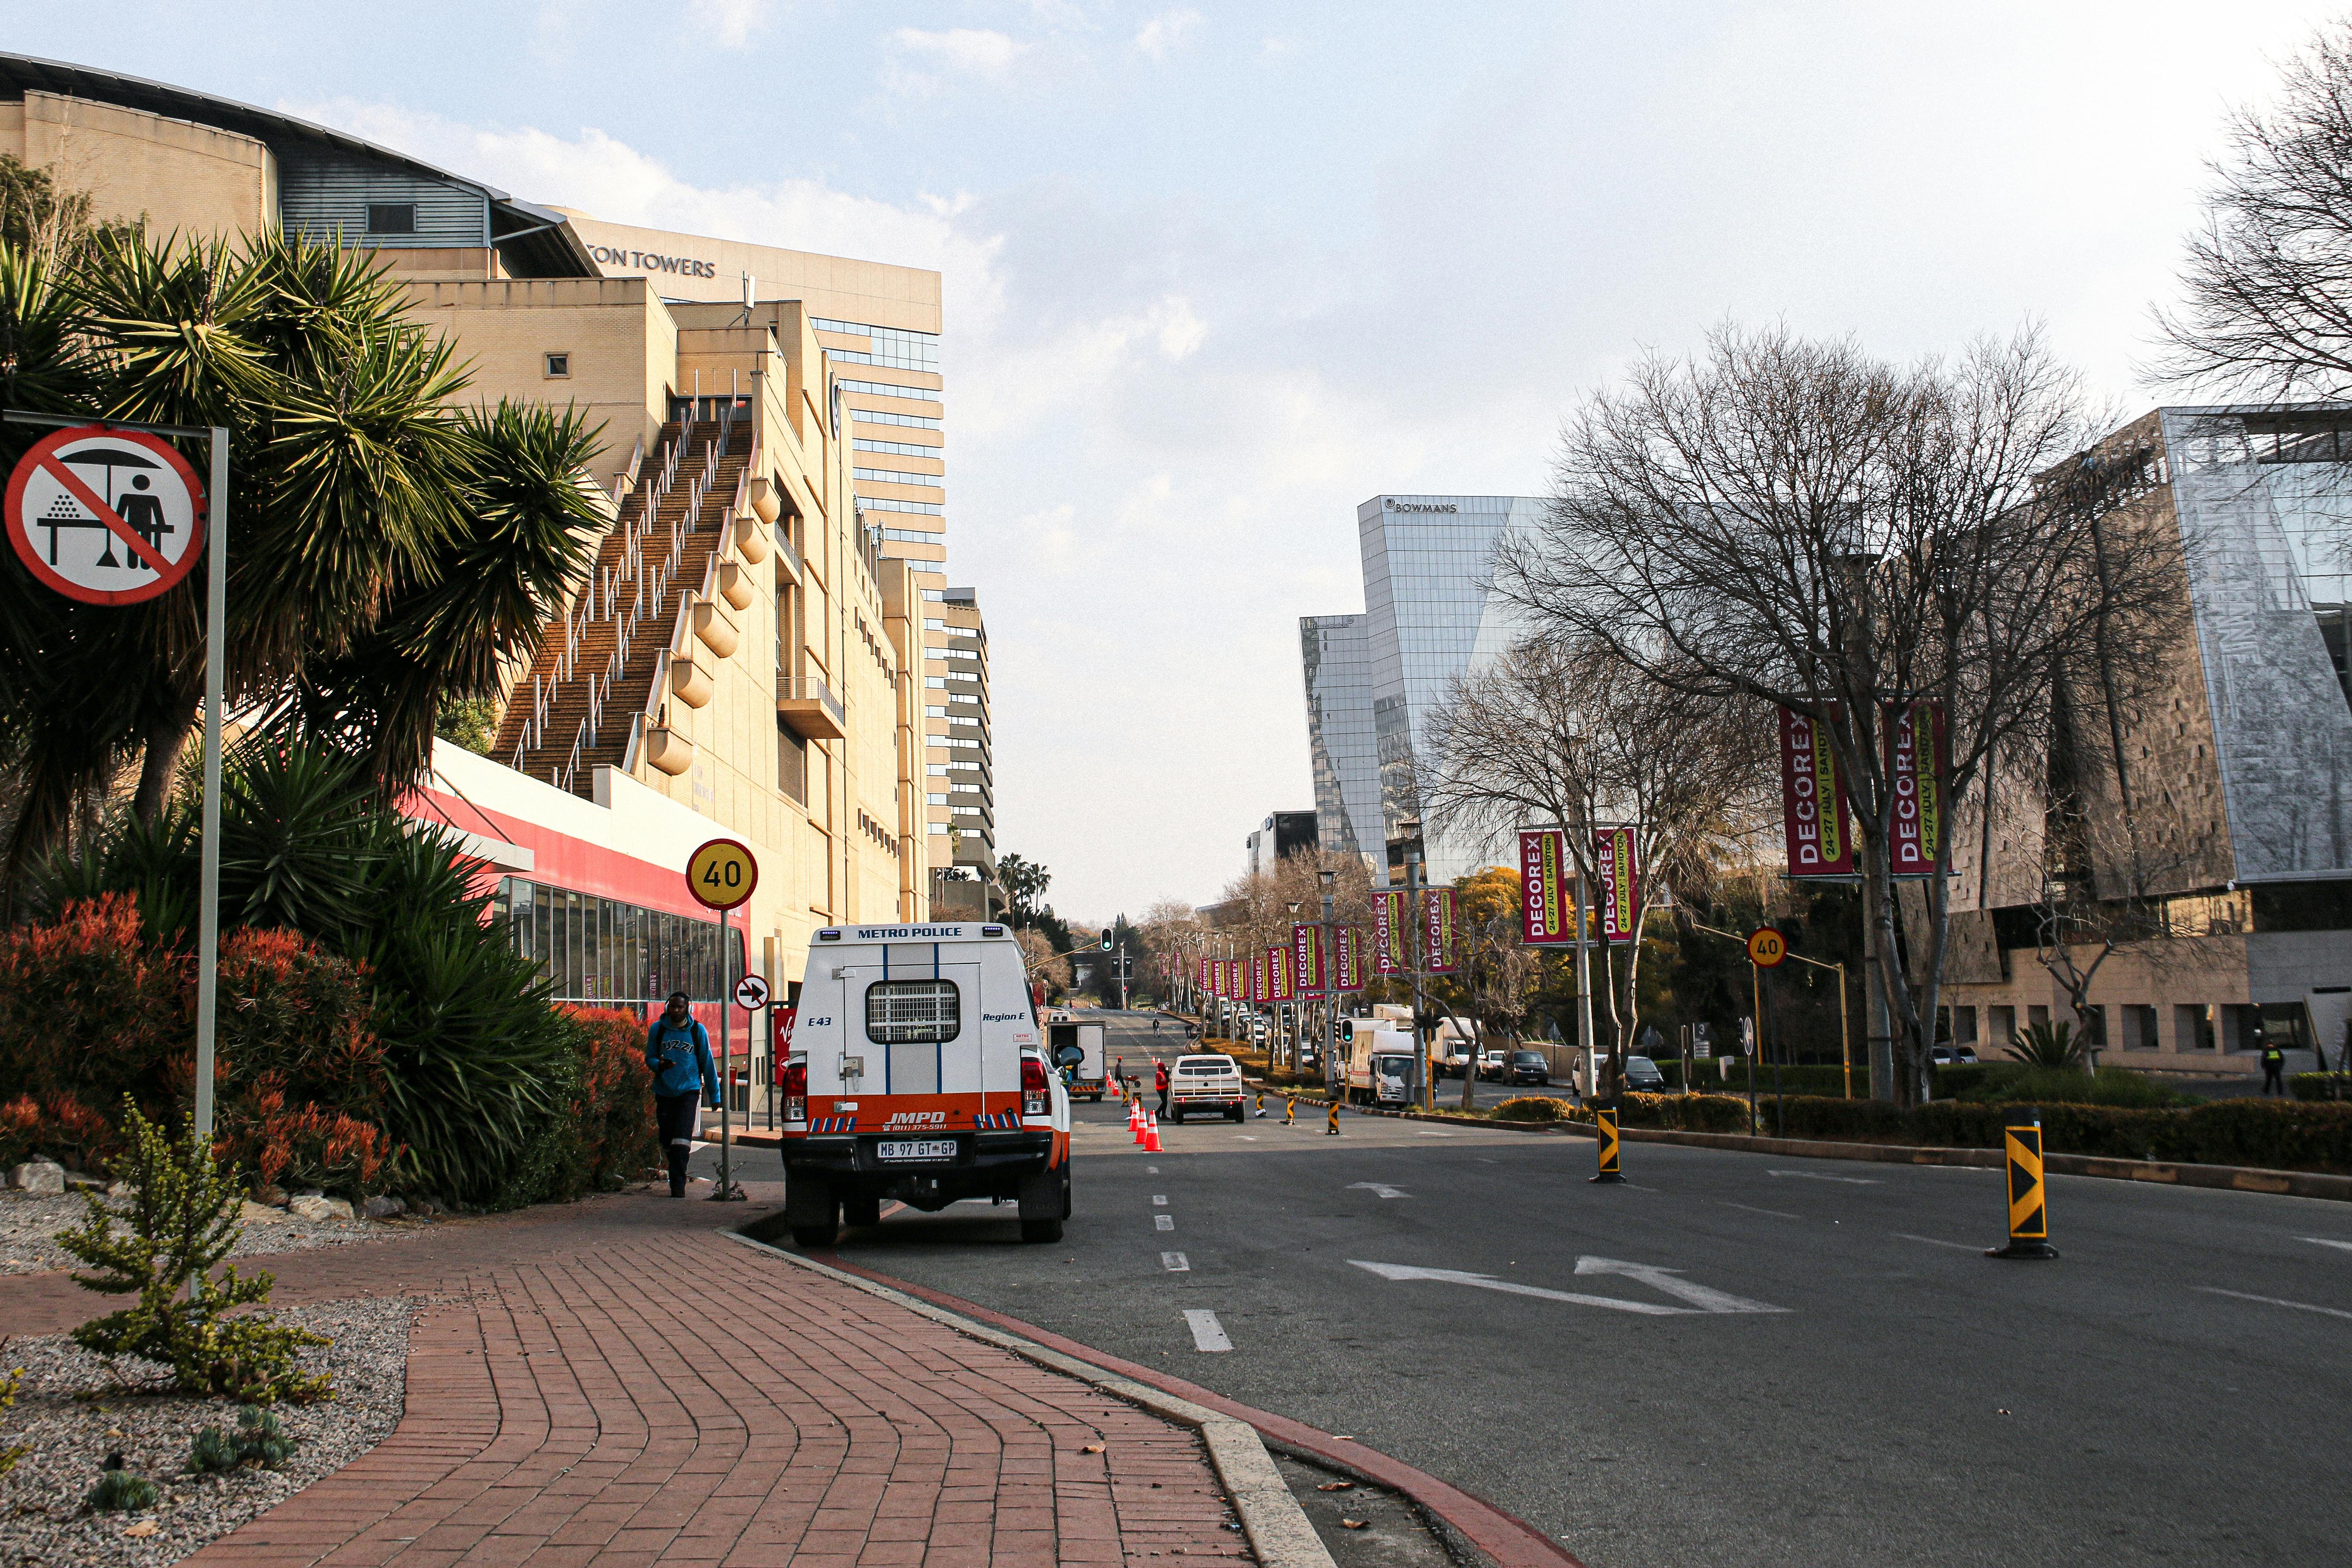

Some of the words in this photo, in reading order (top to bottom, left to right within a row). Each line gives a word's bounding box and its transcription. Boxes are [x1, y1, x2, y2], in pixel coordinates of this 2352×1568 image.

[632, 251, 716, 279] TOWERS
[1396, 503, 1457, 512] BOWMANS
[1790, 711, 1818, 864] DECOREX
[1822, 786, 1832, 815] JULY
[1922, 785, 1932, 815] JULY
[1823, 818, 1835, 856] 24-27
[703, 860, 741, 888] 40
[1527, 837, 1544, 936] DECOREX
[858, 928, 908, 939] METRO
[912, 927, 962, 937] POLICE
[1430, 894, 1442, 967] DECOREX
[1298, 928, 1307, 986] DECOREX
[1340, 928, 1348, 986] DECOREX
[1757, 939, 1778, 956] 40
[1272, 950, 1280, 997] DECOREX
[808, 1018, 815, 1026] E
[816, 1017, 831, 1026] 43
[983, 1013, 1017, 1022] Region
[1699, 1024, 1705, 1035] 3
[885, 1112, 946, 1124] JMPD
[881, 1143, 894, 1156] MB
[900, 1143, 913, 1156] 97
[918, 1142, 931, 1155] GT
[941, 1142, 955, 1155] GP
